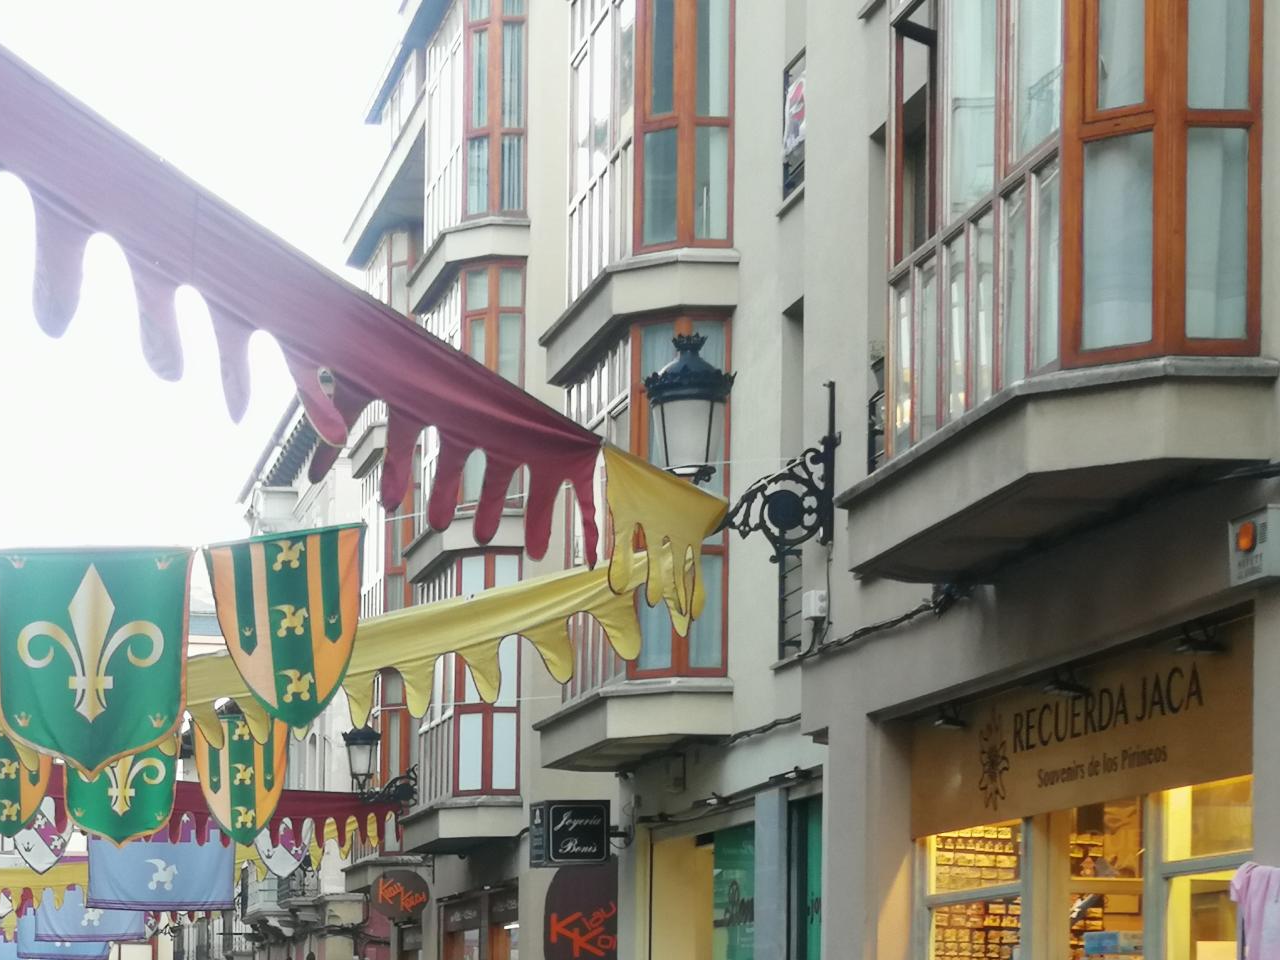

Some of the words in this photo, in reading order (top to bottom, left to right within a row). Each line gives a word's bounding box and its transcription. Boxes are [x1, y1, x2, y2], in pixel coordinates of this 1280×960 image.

[1013, 688, 1129, 753] RECUERDA
[1136, 662, 1204, 721] JACA
[1037, 760, 1085, 788] Souvenirs
[1088, 756, 1101, 777] de
[1103, 752, 1118, 774] los
[1121, 745, 1168, 770] Pirineos
